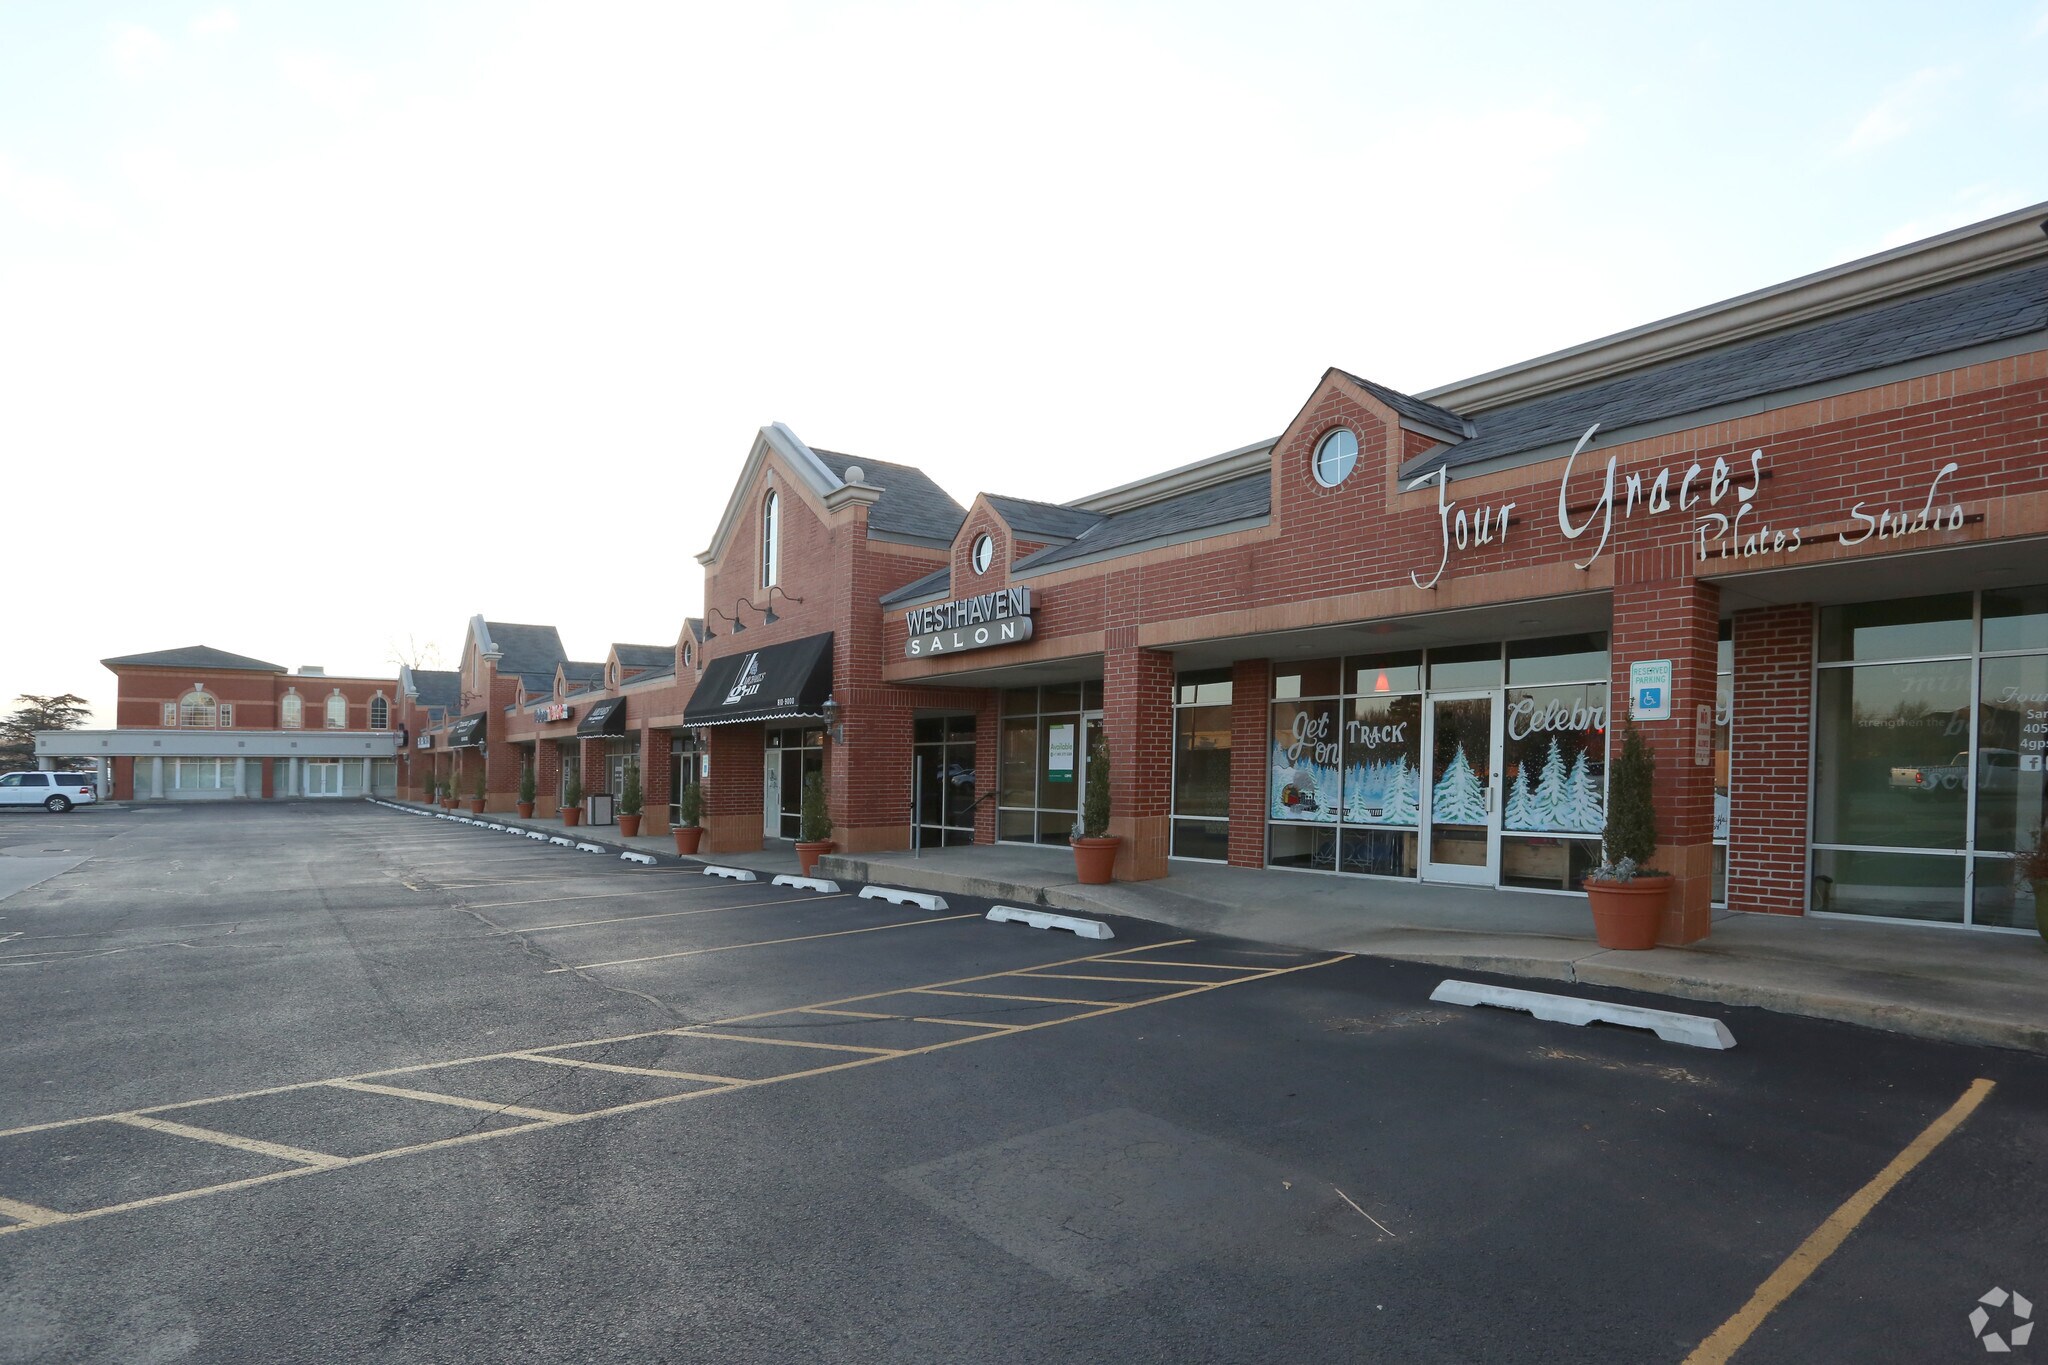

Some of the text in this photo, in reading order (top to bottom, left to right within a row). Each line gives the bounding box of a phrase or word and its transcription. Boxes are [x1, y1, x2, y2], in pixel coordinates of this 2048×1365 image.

[1559, 422, 1763, 571] Graces
[1694, 462, 1964, 563] Pilates Studio
[905, 586, 1031, 637] WESTHAVEN
[910, 621, 1016, 655] SALON
[1633, 666, 1668, 676] RESERVED
[1635, 675, 1666, 685] PARKING
[1858, 709, 2012, 749] strengthen the bdy
[1050, 743, 1073, 751] Available
[1315, 741, 1340, 764] on
